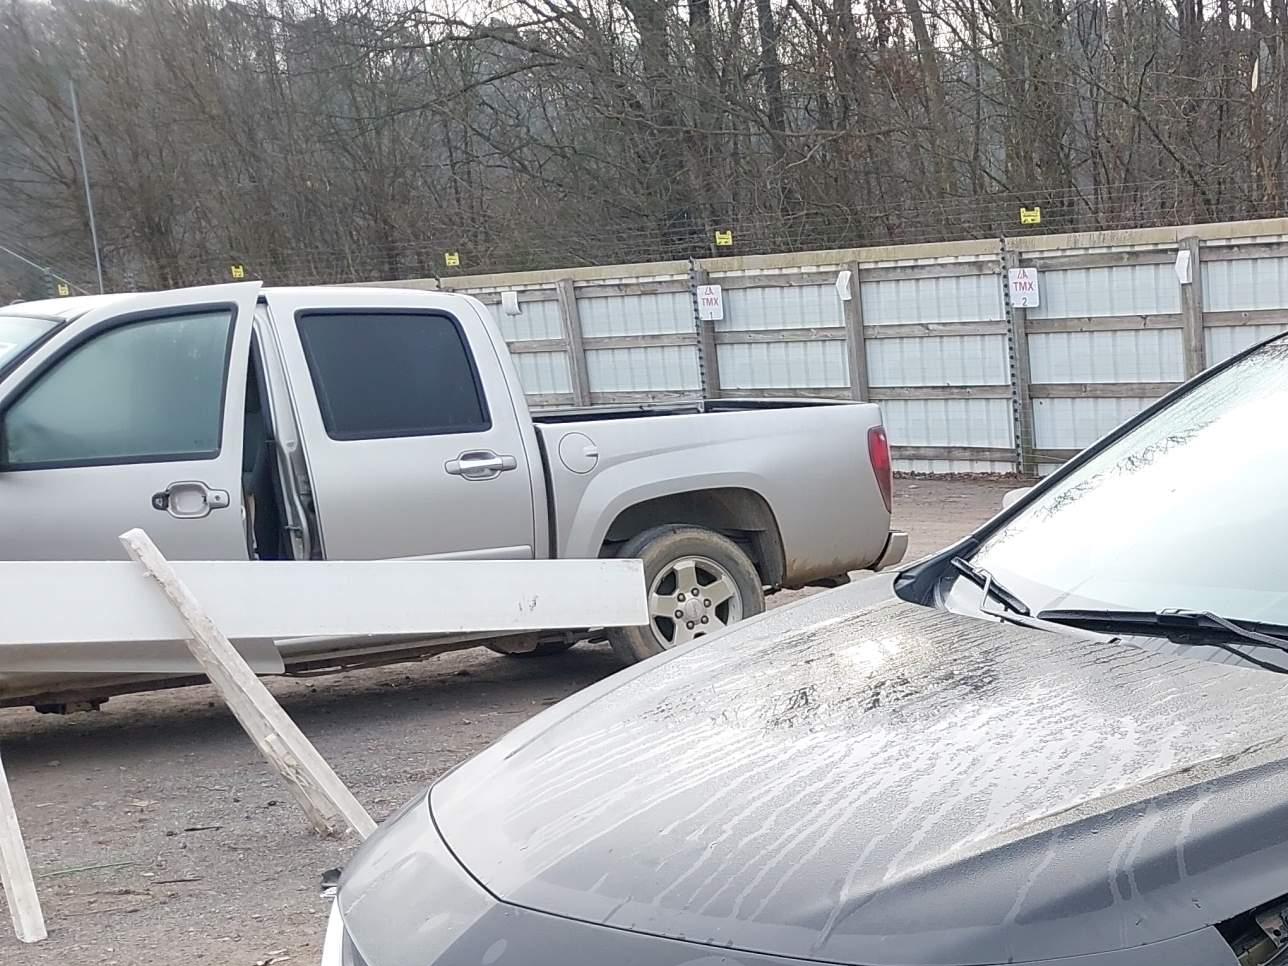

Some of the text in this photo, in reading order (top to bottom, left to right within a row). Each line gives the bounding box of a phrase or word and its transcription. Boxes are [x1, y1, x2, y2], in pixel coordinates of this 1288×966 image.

[1013, 281, 1034, 292] TMX
[701, 297, 719, 307] TMX
[1022, 296, 1028, 307] 2
